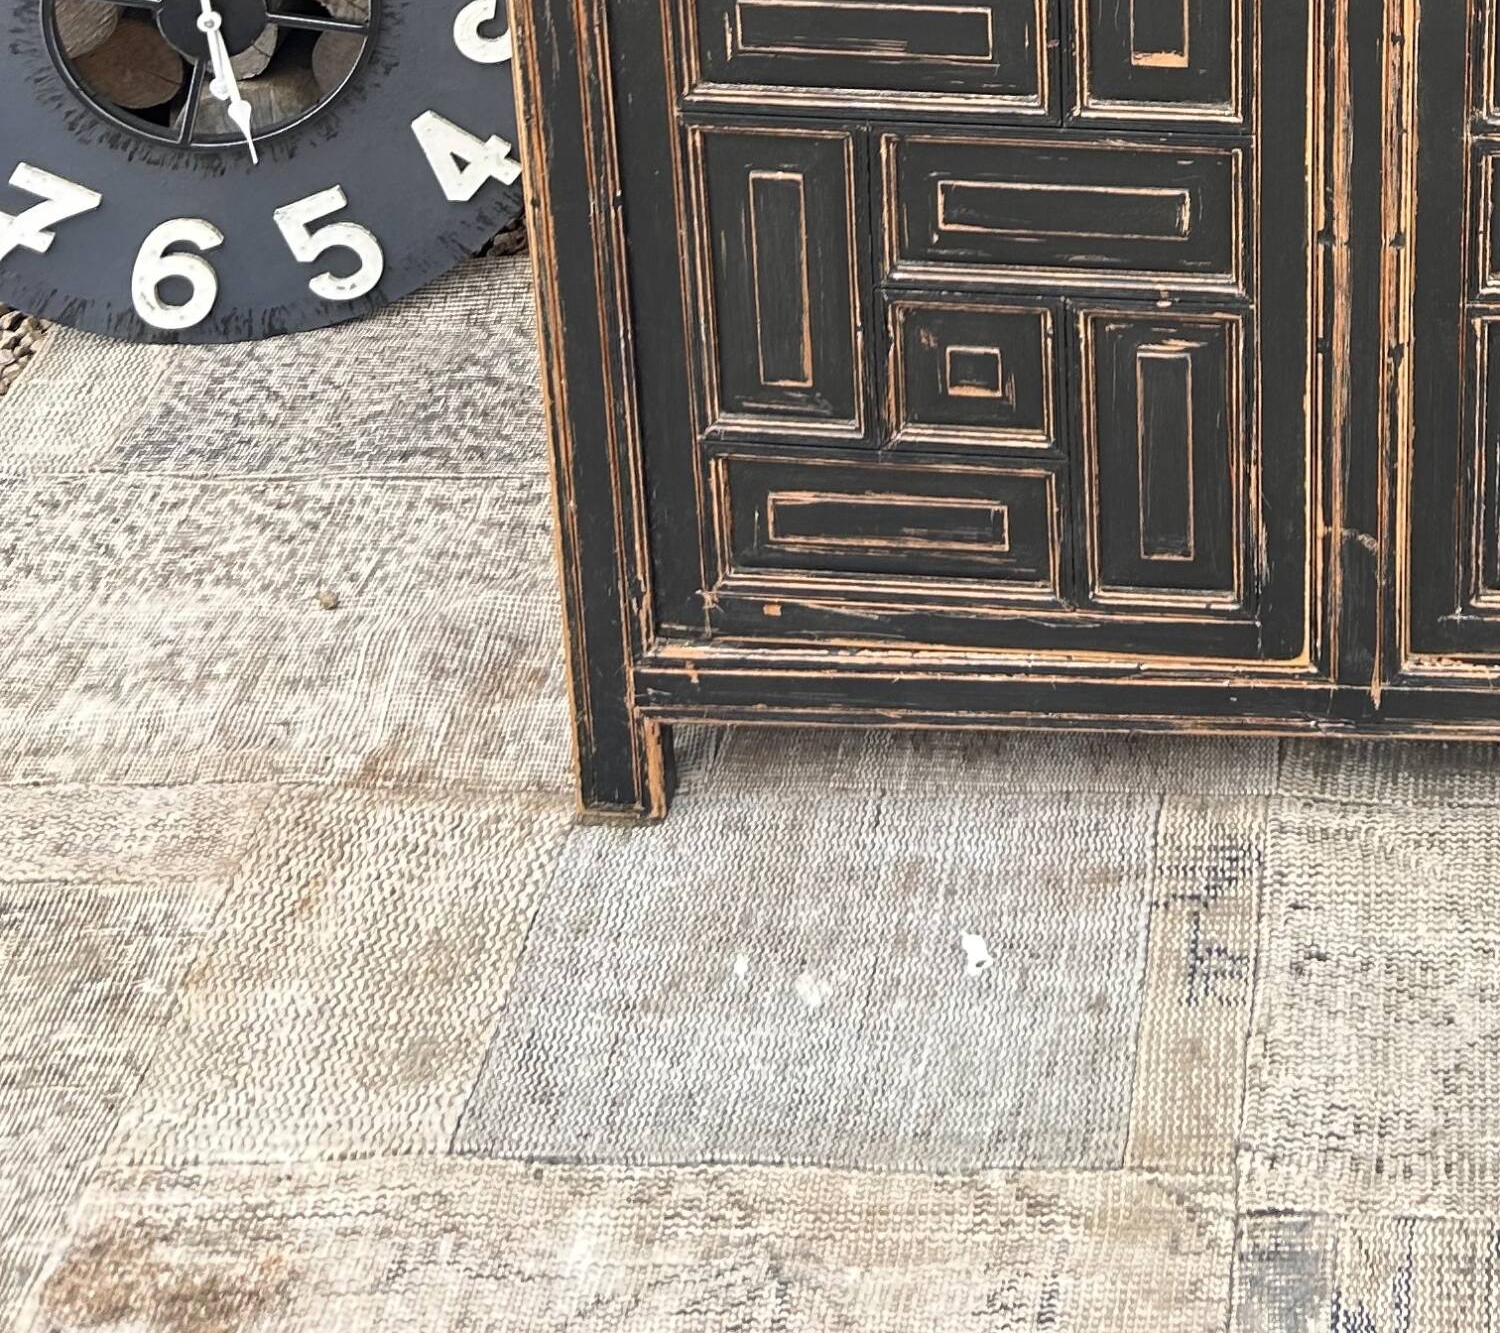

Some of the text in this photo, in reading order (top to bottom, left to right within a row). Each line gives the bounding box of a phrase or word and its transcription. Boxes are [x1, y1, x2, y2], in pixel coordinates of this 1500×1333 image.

[410, 110, 521, 202] 4
[131, 217, 224, 330] 6
[273, 184, 384, 301] 5
